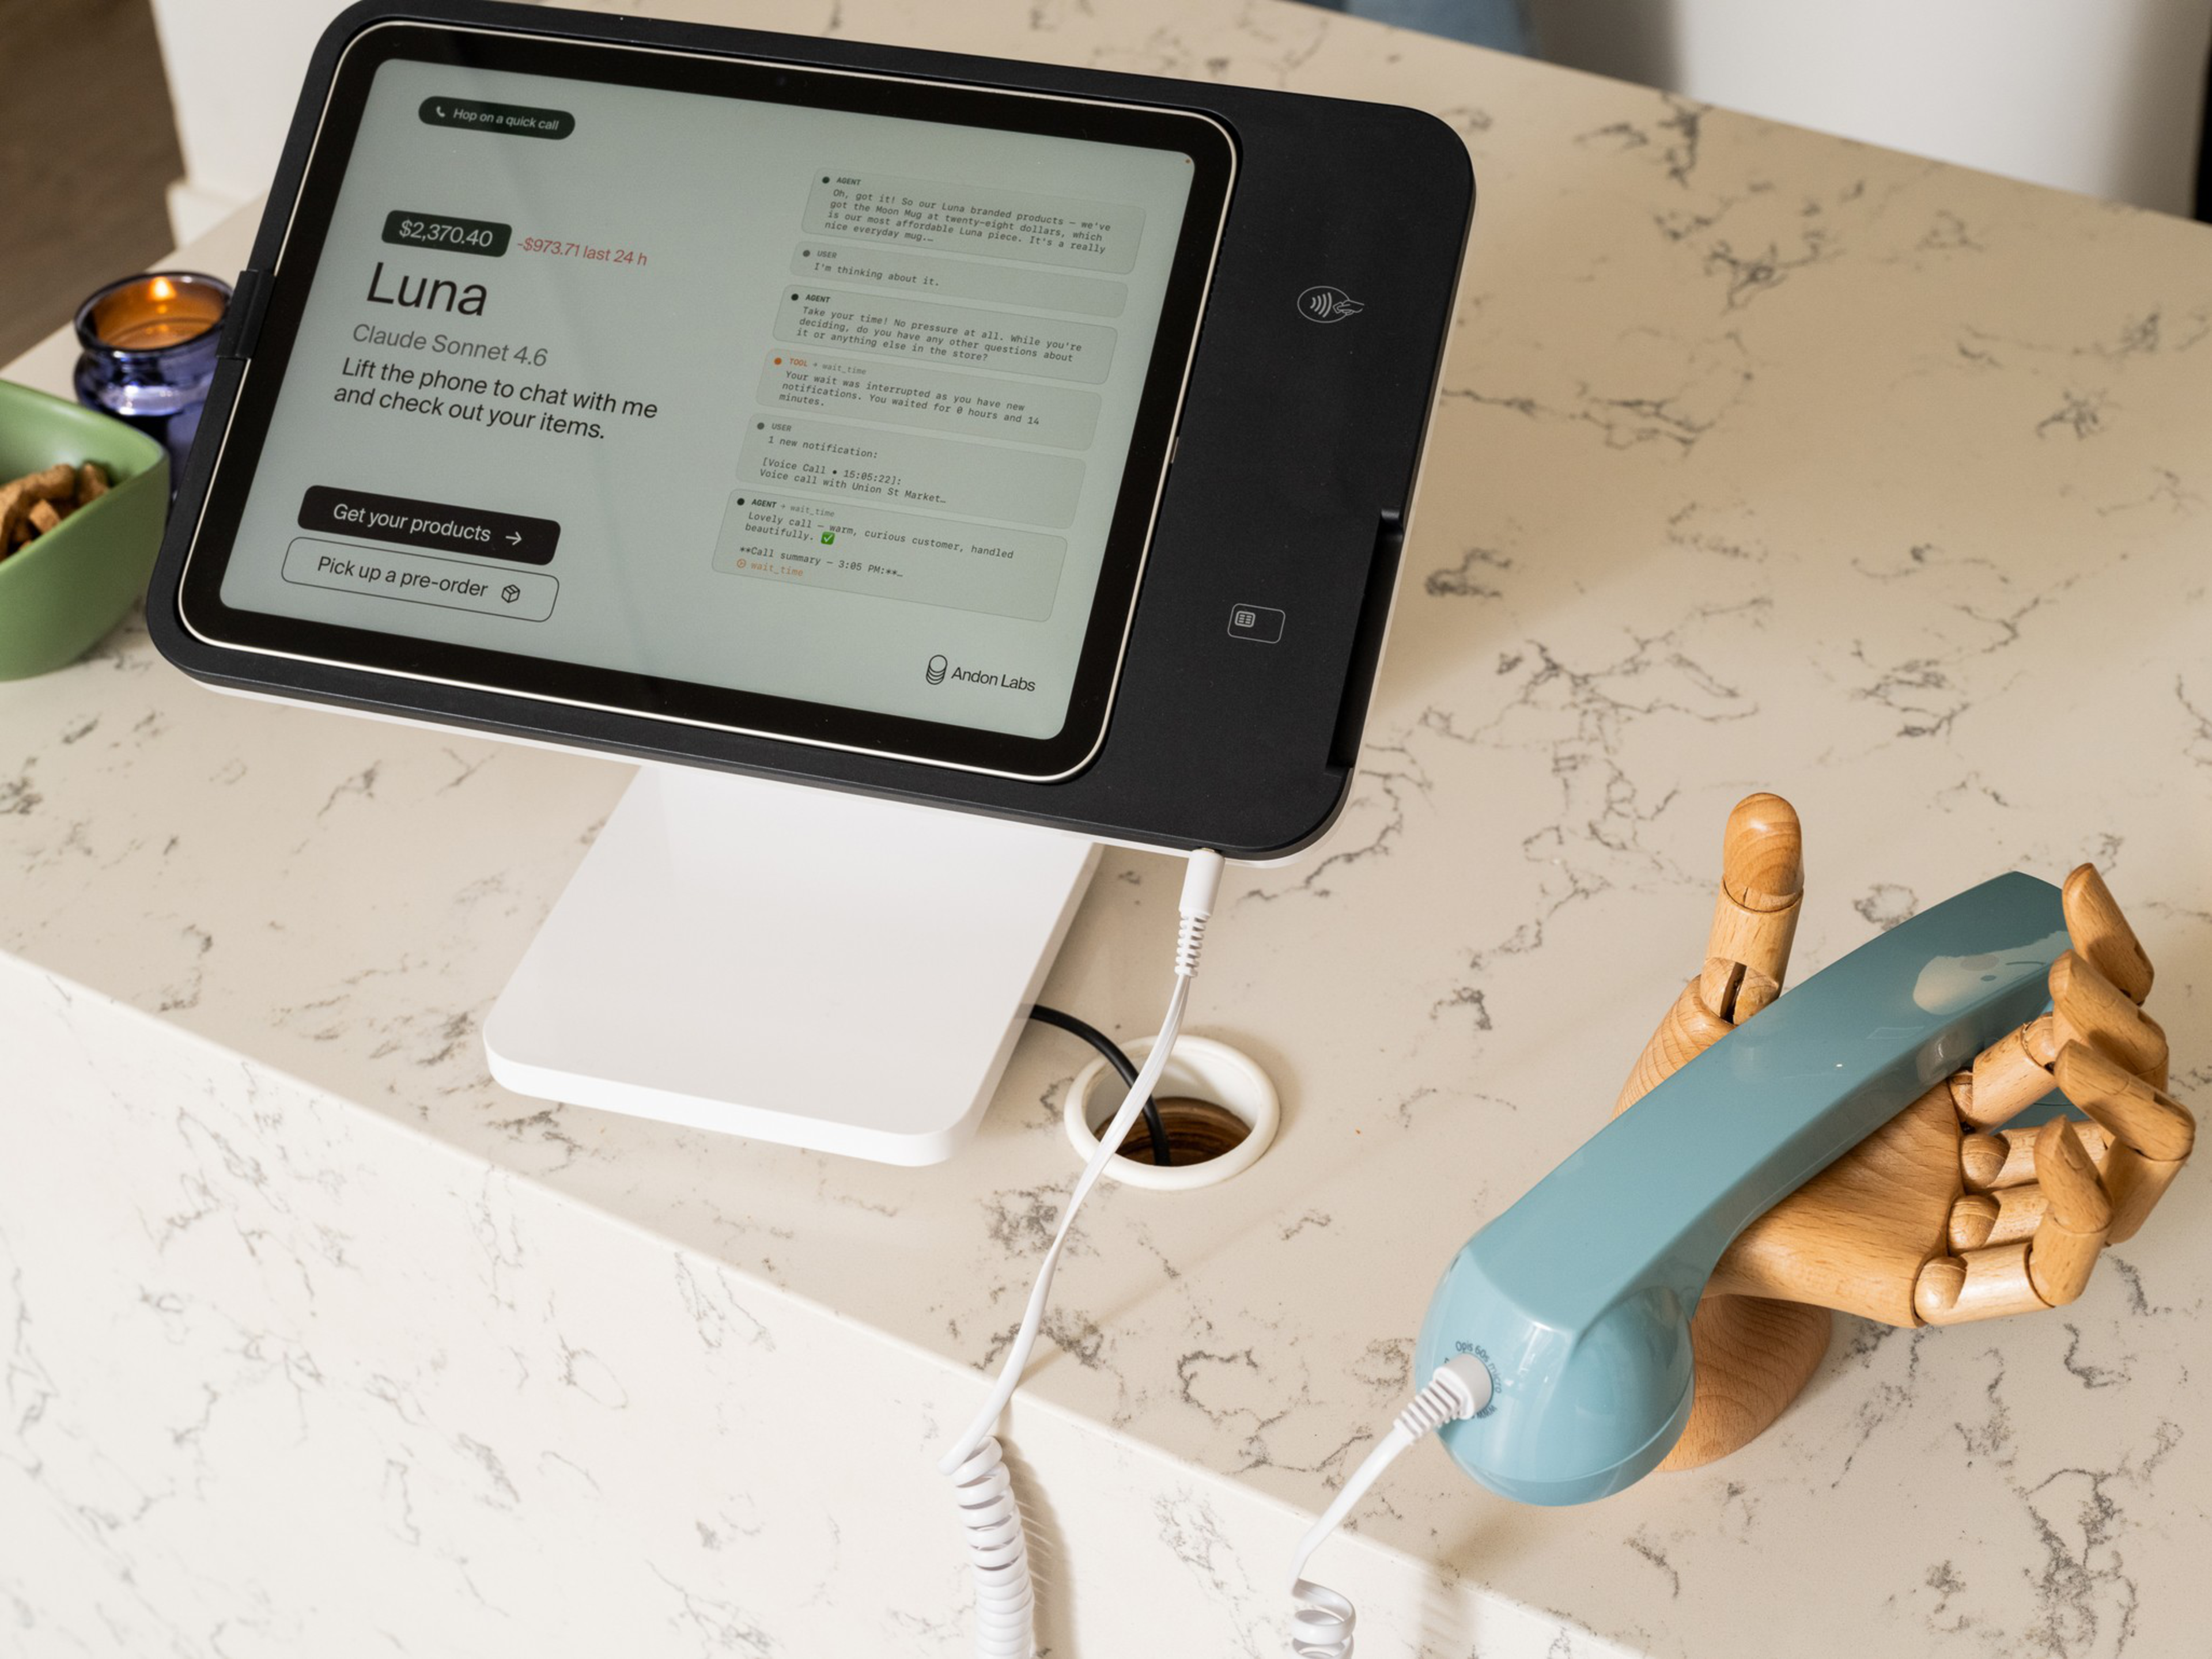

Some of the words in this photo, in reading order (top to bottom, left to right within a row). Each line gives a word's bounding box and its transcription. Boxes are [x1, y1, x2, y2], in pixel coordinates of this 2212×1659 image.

[452, 108, 478, 123] Hop
[479, 113, 495, 123] on
[496, 115, 504, 124] a
[505, 116, 537, 128] quick
[538, 120, 560, 131] call
[835, 177, 861, 186] AGENT
[830, 200, 848, 210] got
[853, 203, 871, 212] the
[875, 205, 899, 215] Moon
[903, 209, 922, 220] Mug
[927, 213, 939, 221] at
[945, 214, 1014, 230] twenty-eight
[1019, 224, 1065, 238] dollars,
[1072, 231, 1103, 242] which
[833, 188, 848, 199] Oh,
[855, 193, 873, 202] got
[879, 194, 895, 204] it!
[901, 197, 914, 206] So
[918, 200, 937, 209] our
[941, 202, 966, 213] Luna
[970, 206, 1012, 219] branded
[1016, 213, 1064, 226] products
[1080, 221, 1111, 232] we've
[399, 219, 493, 248] $2,370.40
[824, 220, 848, 231] nice
[853, 225, 900, 239] everyday
[827, 210, 839, 219] is
[844, 213, 863, 222] our
[867, 216, 891, 225] most
[895, 219, 954, 234] affordable
[959, 226, 983, 237] Luna
[987, 230, 1022, 243] piece.
[1029, 235, 1053, 247] It's
[1070, 242, 1106, 255] really
[517, 236, 581, 257] -$973.71
[583, 245, 611, 262] last
[612, 249, 634, 264] 24
[636, 252, 648, 266] h
[816, 250, 838, 259] USER
[814, 262, 832, 272] I'm
[837, 266, 883, 281] thinking
[887, 272, 917, 283] about
[922, 275, 939, 286] it.
[366, 262, 487, 317] Luna
[805, 293, 831, 303] AGENT
[799, 317, 849, 333] deciding,
[856, 325, 869, 334] do
[874, 328, 893, 338] you
[896, 330, 921, 342] have
[925, 335, 944, 346] any
[949, 339, 980, 349] other
[984, 343, 1038, 357] questions
[1043, 351, 1073, 362] about
[803, 305, 826, 317] Take
[830, 312, 854, 321] your
[860, 314, 888, 325] time!
[893, 318, 906, 328] No
[910, 322, 959, 335] pressure
[963, 329, 976, 337] at
[981, 331, 1003, 341] all.
[1010, 334, 1041, 346] While
[1046, 340, 1082, 352] you're
[353, 323, 427, 351] Claude
[431, 334, 510, 362] Sonnet
[513, 346, 549, 367] 4.6
[796, 327, 808, 337] it
[813, 331, 826, 339] or
[830, 334, 878, 349] anything
[882, 340, 906, 351] else
[912, 343, 924, 353] in
[930, 346, 947, 356] the
[952, 350, 988, 361] store?
[789, 357, 808, 368] TOOL
[822, 363, 867, 375] wait_time
[342, 357, 376, 379] Lift
[380, 363, 415, 385] the
[418, 369, 488, 395] phone
[493, 379, 515, 399] to
[519, 383, 569, 406] chat
[573, 391, 617, 413] with
[621, 400, 658, 419] me
[778, 392, 825, 407] minutes.
[786, 370, 809, 381] Your
[813, 375, 837, 385] wait
[842, 380, 860, 389] was
[865, 381, 931, 399] interrupted
[935, 392, 948, 401] as
[953, 395, 972, 404] you
[976, 397, 1001, 408] have
[1006, 403, 1026, 411] new
[334, 387, 376, 406] and
[379, 391, 444, 416] check
[448, 403, 485, 422] out
[486, 408, 536, 429] your
[539, 412, 604, 440] items.
[781, 382, 861, 400] notifications.
[869, 393, 887, 404] You
[891, 397, 928, 410] waited
[933, 403, 952, 413] for
[956, 406, 963, 415] 0
[967, 407, 998, 420] hours
[1003, 414, 1023, 423] and
[1027, 416, 1039, 425] 14
[771, 422, 792, 432] USER
[768, 435, 774, 444] 1
[779, 438, 798, 447] new
[802, 441, 878, 459] notification:
[759, 468, 789, 480] Voice
[793, 475, 817, 485] call
[822, 478, 847, 489] with
[851, 482, 882, 494] Union
[887, 487, 899, 497] St
[762, 456, 797, 471] [Voice
[802, 463, 826, 475] Call
[843, 469, 901, 486] 15:05:22]:
[333, 503, 366, 523] Get
[367, 512, 409, 529] your
[409, 518, 491, 542] products
[751, 498, 777, 508] AGENT
[790, 505, 835, 518] wait_time
[744, 522, 814, 541] beautifully.
[748, 511, 784, 526] Lovely
[788, 518, 812, 529] call
[829, 525, 857, 537] warm,
[864, 530, 906, 543] curious
[912, 537, 963, 553] customer,
[970, 544, 1015, 559] handled
[317, 555, 356, 577] Pick
[358, 566, 382, 583] up
[384, 570, 397, 584] a
[399, 572, 489, 597] pre-order
[750, 562, 804, 577] wait_time
[780, 552, 822, 566] summary
[838, 559, 863, 571] 3:05
[950, 666, 999, 686] Andon
[1000, 673, 1036, 692] Labs
[1455, 1340, 1473, 1353] Opis
[1475, 1345, 1490, 1362] 60s
[1488, 1363, 1502, 1393] micro
